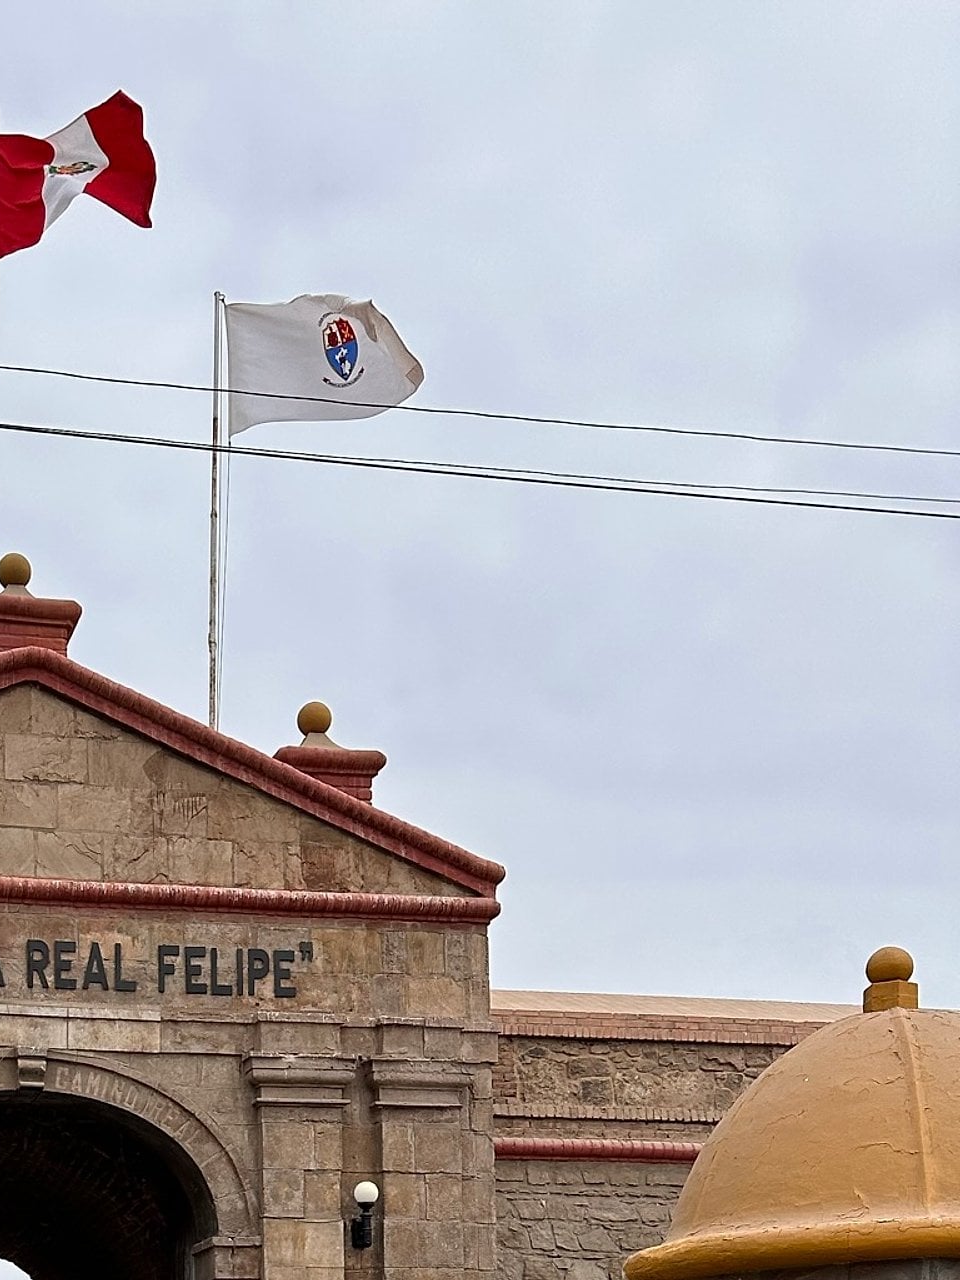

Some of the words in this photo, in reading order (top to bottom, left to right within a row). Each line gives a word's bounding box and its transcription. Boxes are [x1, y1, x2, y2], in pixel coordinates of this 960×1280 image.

[26, 938, 137, 993] REAL
[157, 941, 314, 998] FELIPE"
[54, 1065, 140, 1109] CAMINO
